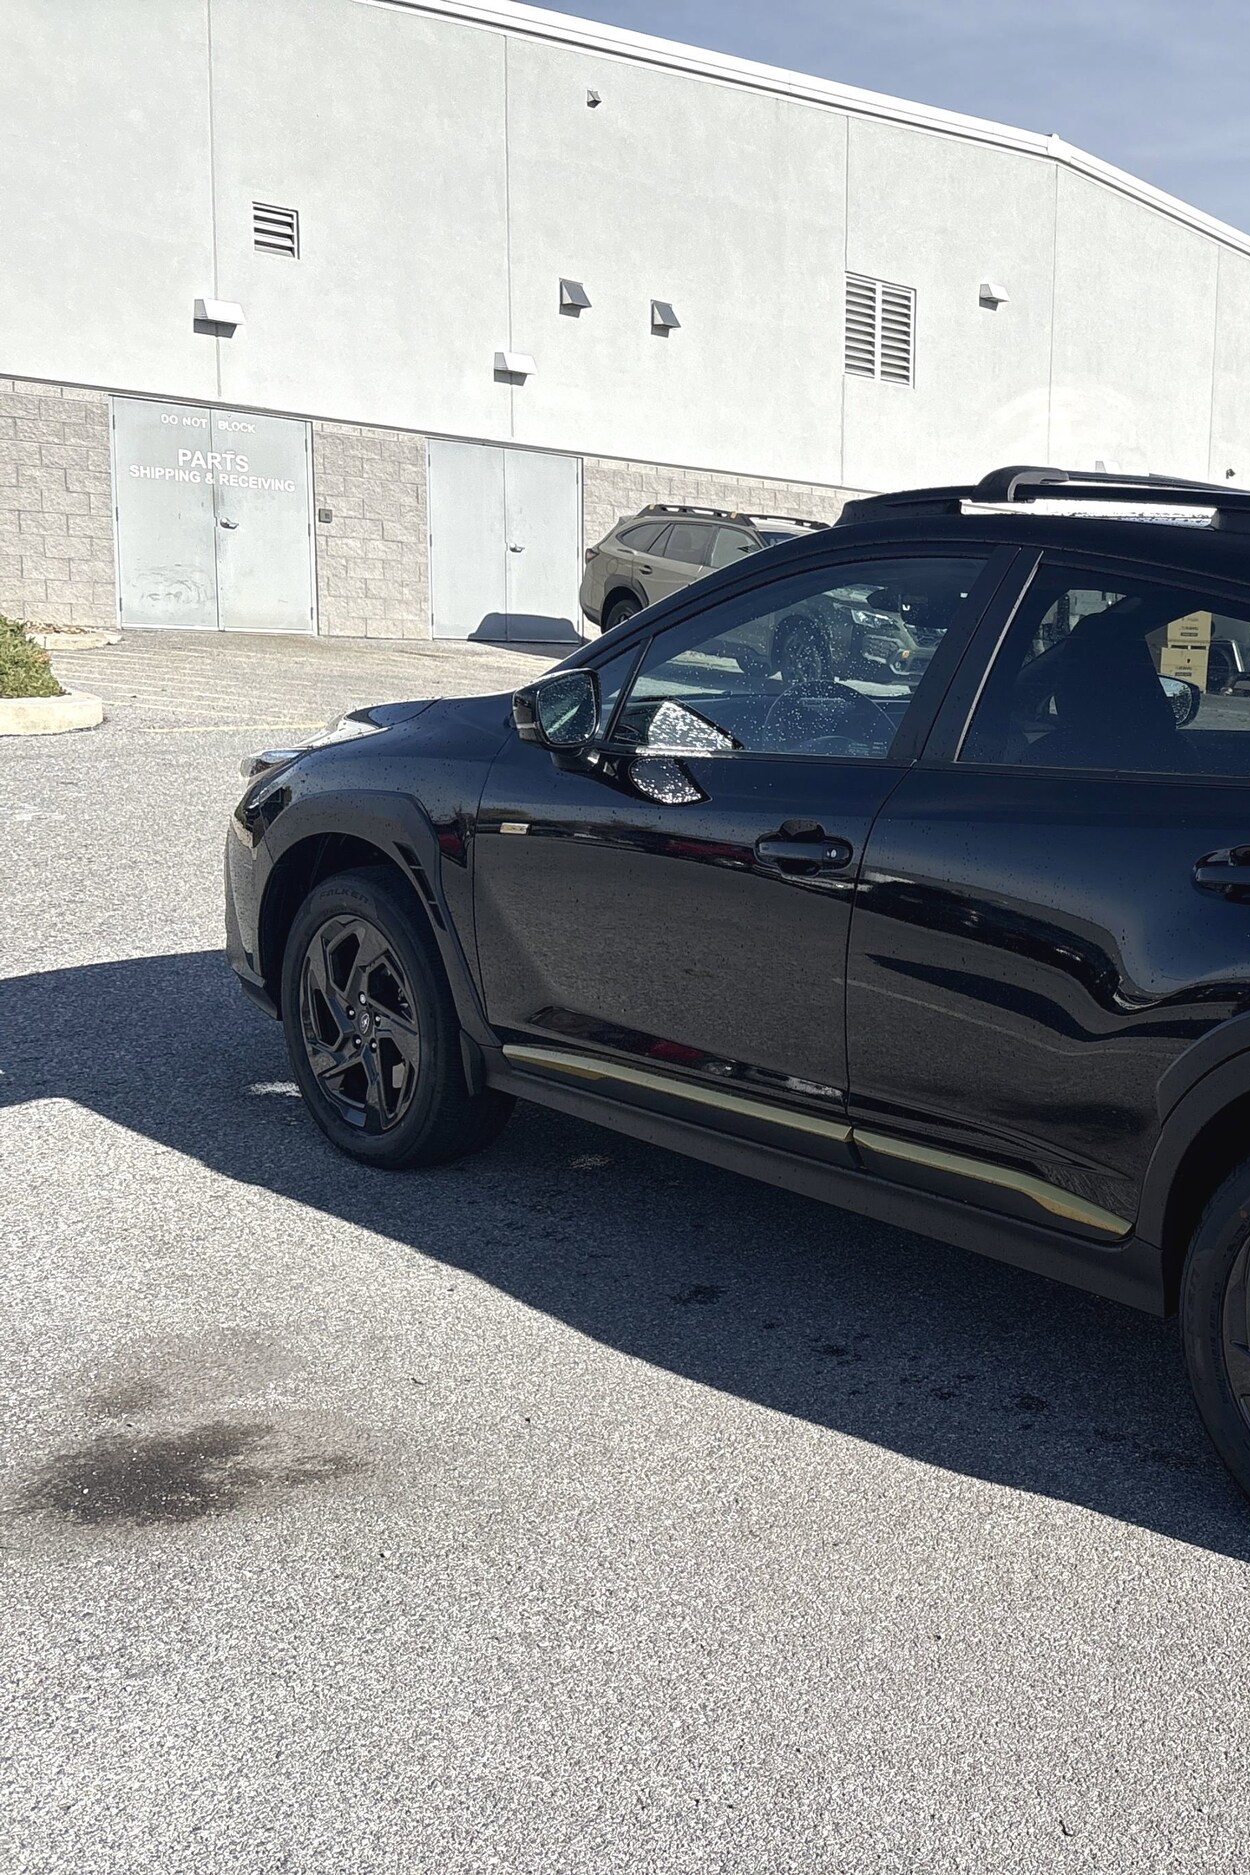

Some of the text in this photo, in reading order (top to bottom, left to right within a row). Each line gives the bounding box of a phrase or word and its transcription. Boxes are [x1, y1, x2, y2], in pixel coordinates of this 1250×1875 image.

[160, 413, 257, 434] DO NOT BLOCK
[178, 448, 249, 473] PARTS
[128, 464, 296, 492] SHIPPING & RECEIVING
[319, 888, 369, 904] FALKEN
